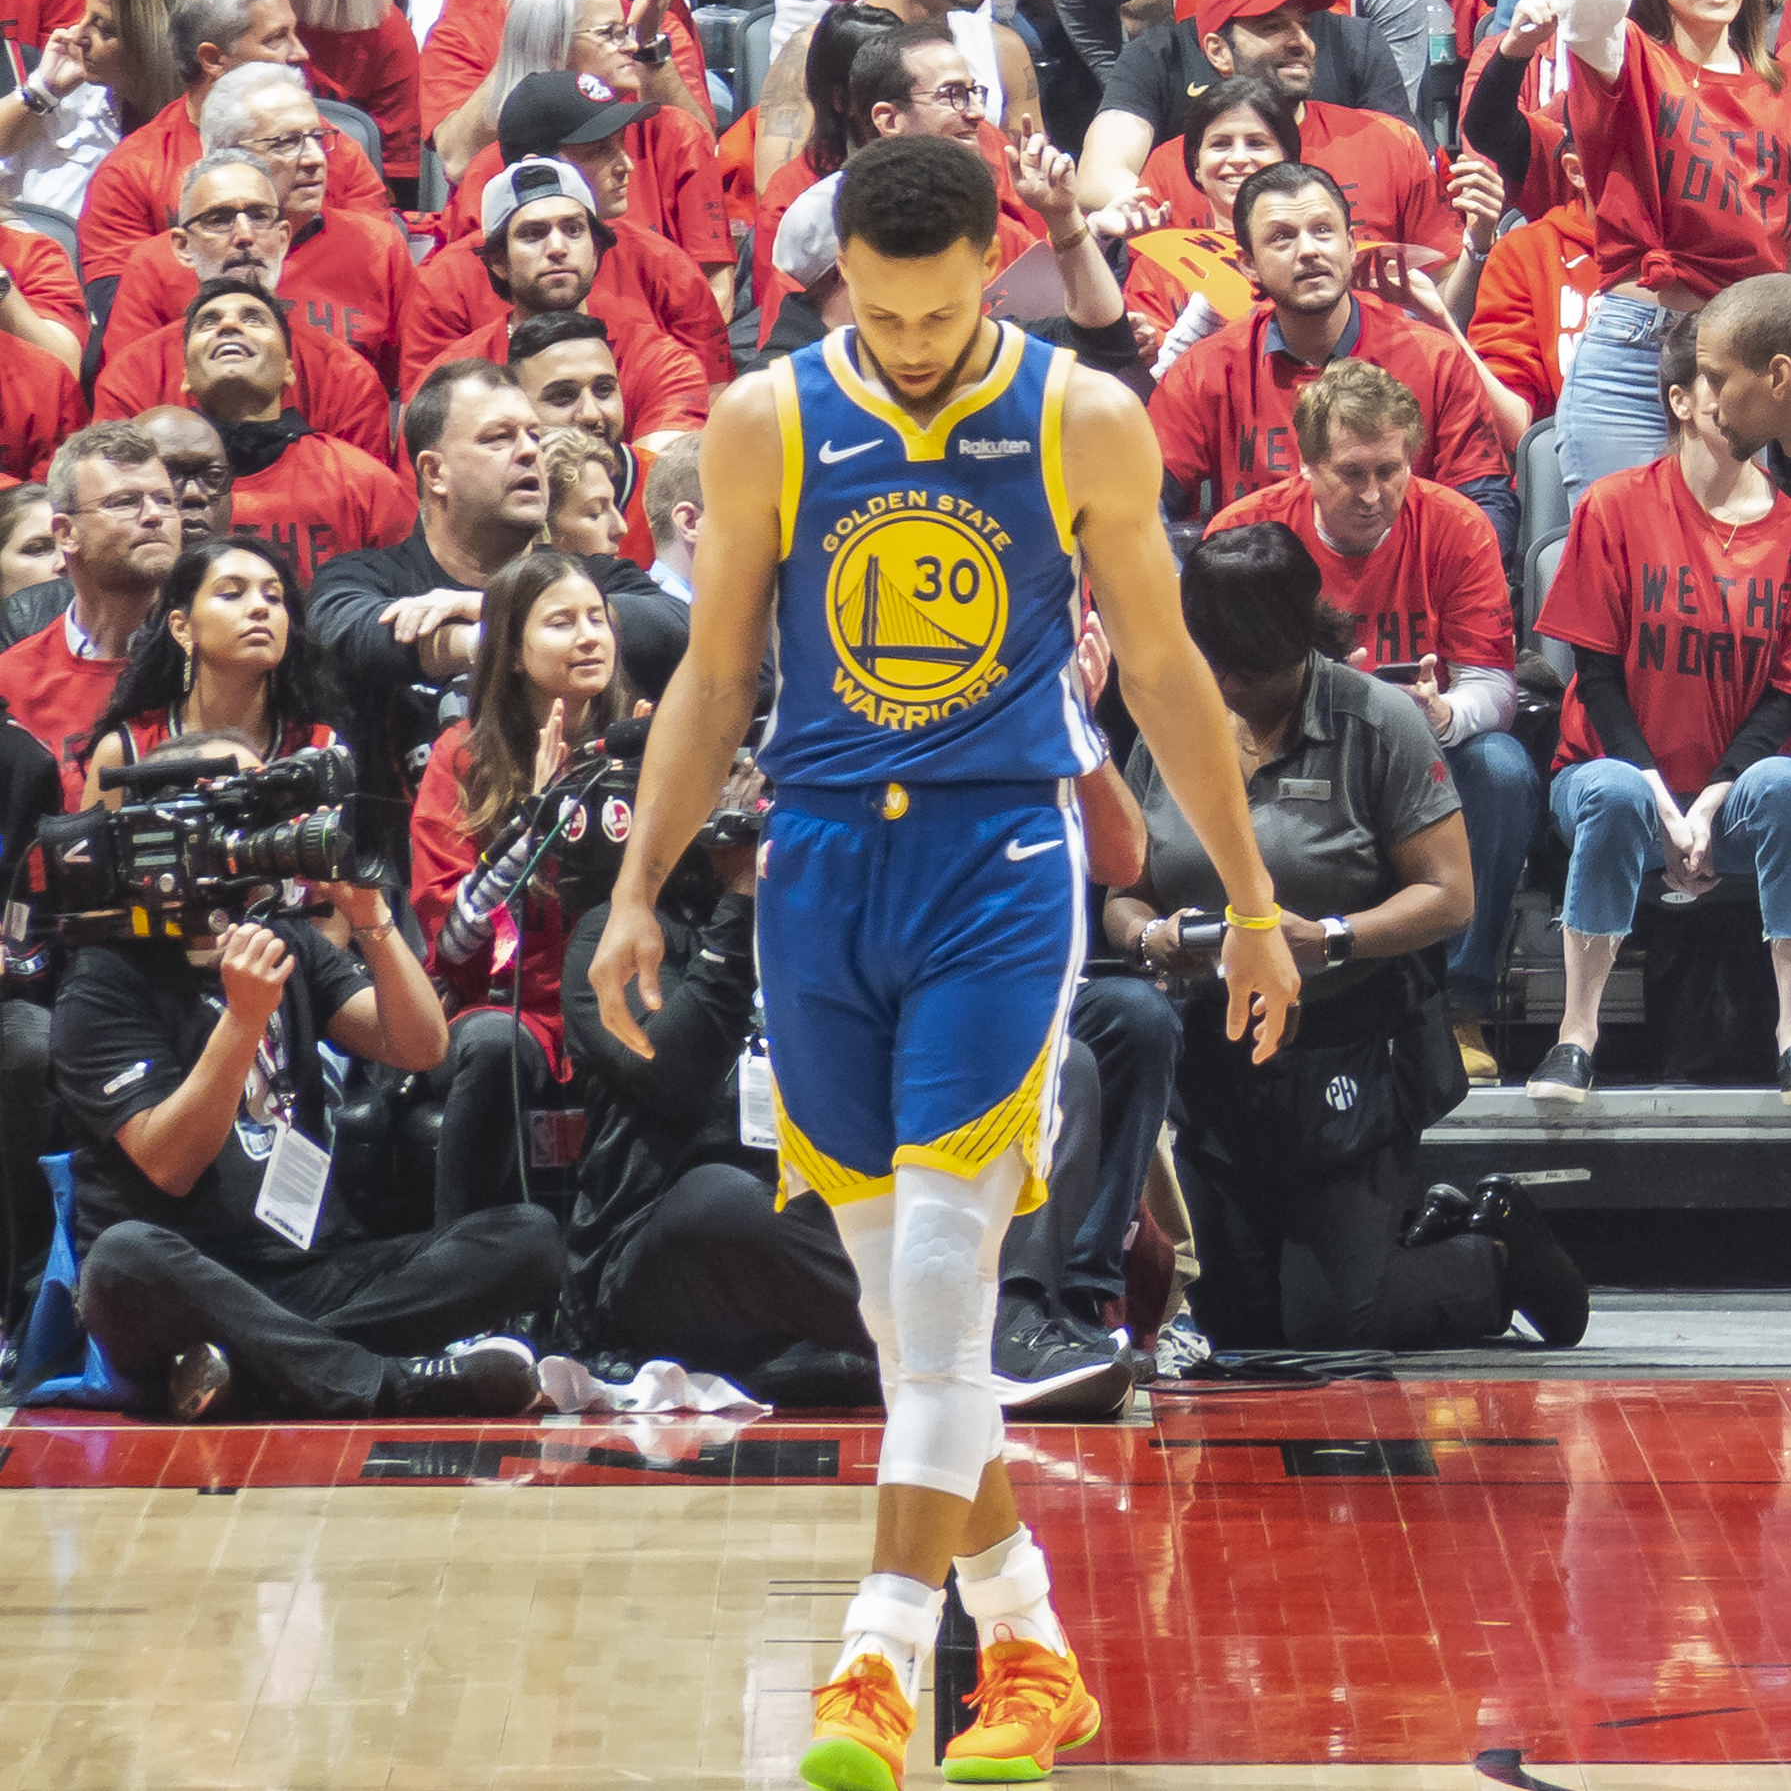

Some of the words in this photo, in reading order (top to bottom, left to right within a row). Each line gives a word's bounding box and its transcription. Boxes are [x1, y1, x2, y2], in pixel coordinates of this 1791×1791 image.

[1658, 91, 1717, 147] WE
[959, 437, 1031, 455] Rakuten
[1238, 422, 1291, 474] WE
[821, 490, 929, 552] GOLDEN
[936, 493, 1014, 554] STATE
[912, 555, 982, 608] 30
[1642, 562, 1700, 615] WE
[832, 660, 1012, 733] WARRIORS
